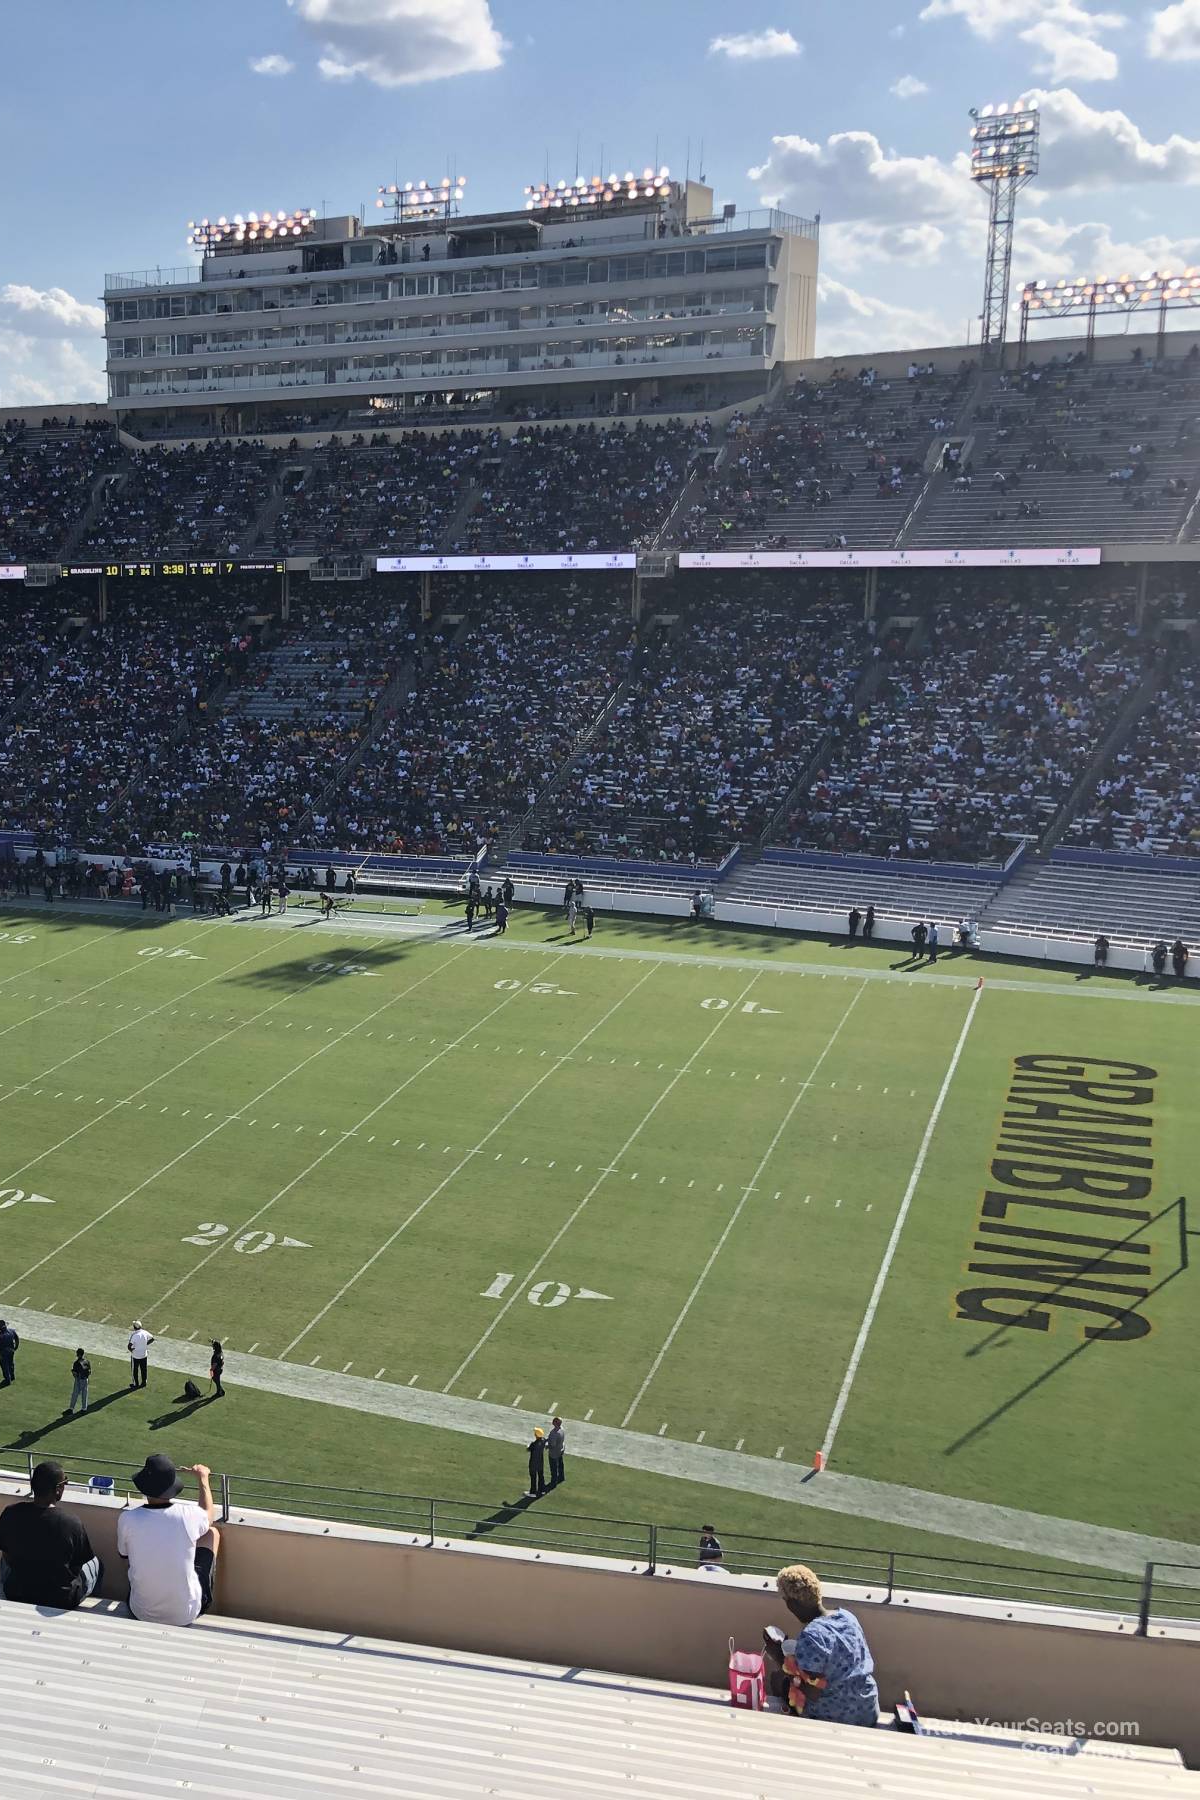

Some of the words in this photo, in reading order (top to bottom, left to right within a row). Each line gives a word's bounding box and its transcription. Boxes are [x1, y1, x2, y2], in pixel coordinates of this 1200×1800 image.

[106, 566, 118, 576] 10
[162, 565, 184, 575] 3:39
[226, 564, 233, 573] 7
[137, 947, 197, 959] 40
[307, 961, 367, 975] 30
[494, 979, 560, 994] 20
[700, 999, 760, 1013] 10
[956, 1055, 1158, 1341] GRAMBLING
[181, 1223, 276, 1254] 20
[479, 1273, 571, 1307] 10
